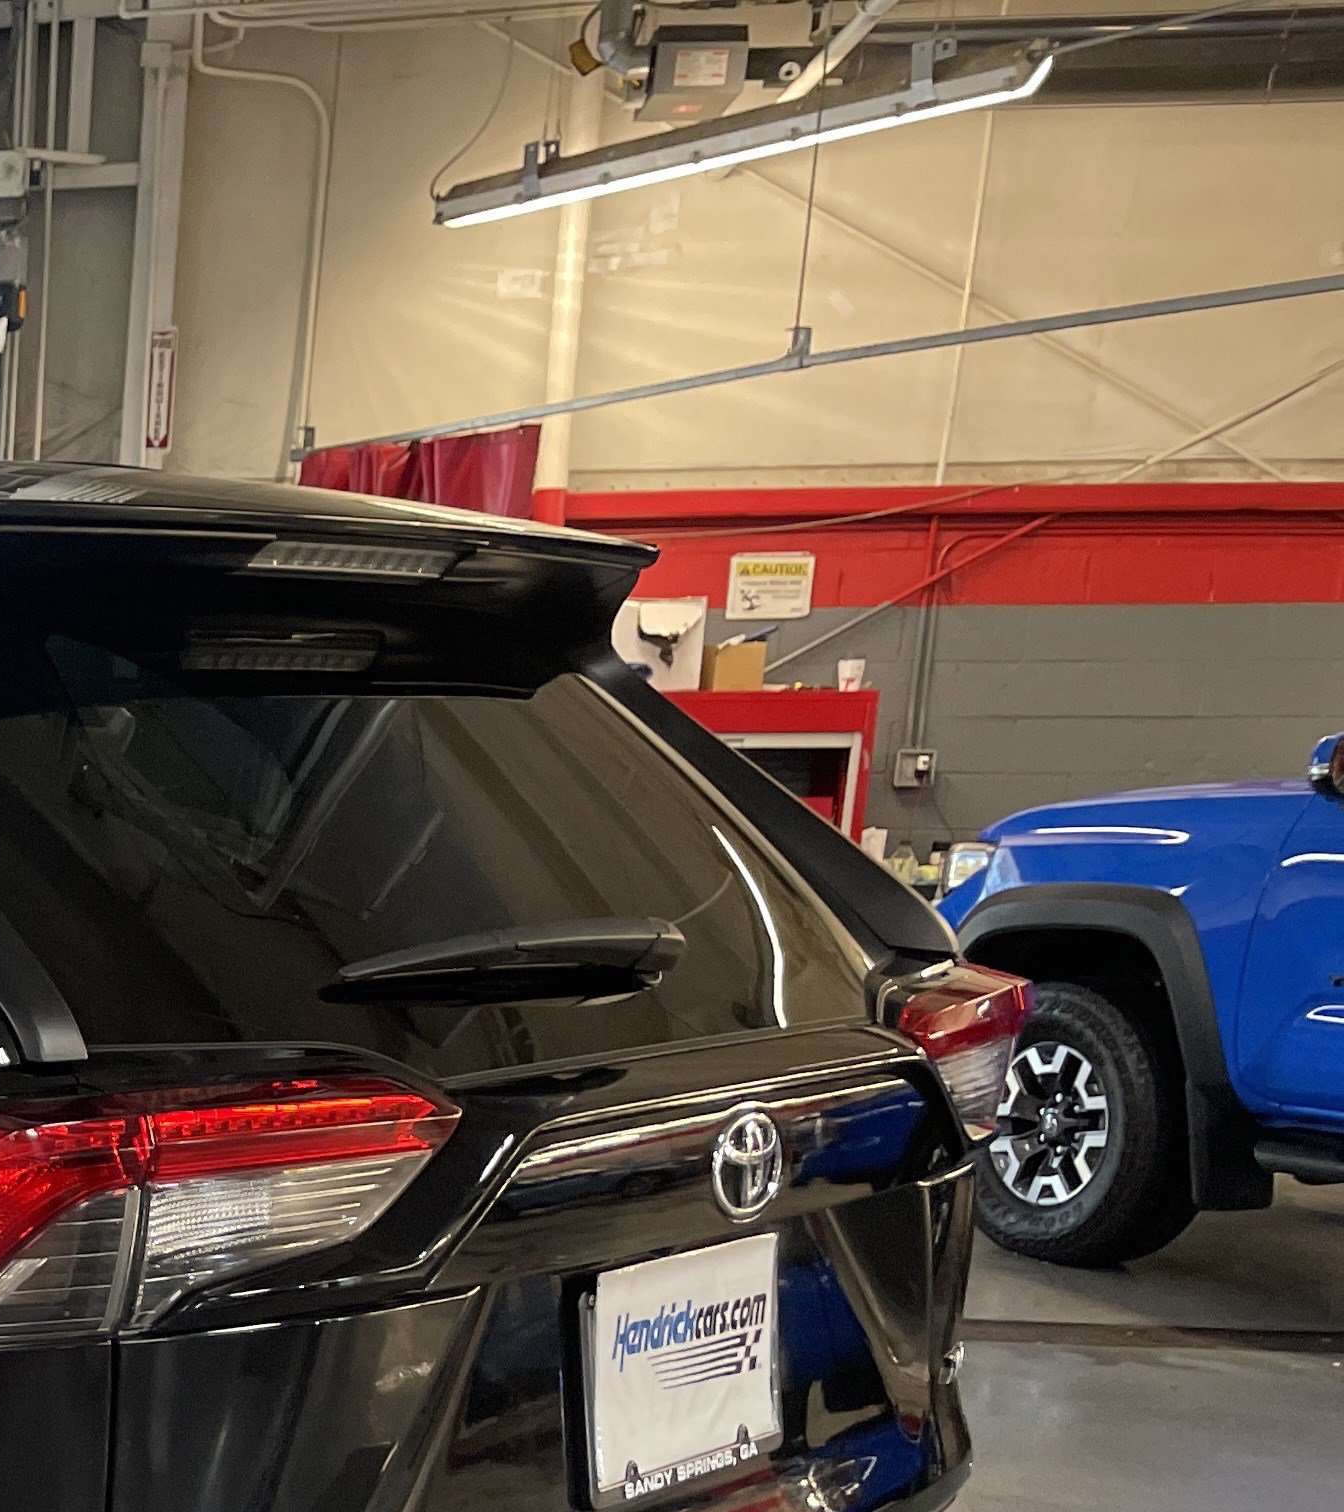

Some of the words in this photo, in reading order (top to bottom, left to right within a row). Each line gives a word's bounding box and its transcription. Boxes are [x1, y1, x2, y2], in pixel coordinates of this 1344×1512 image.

[752, 563, 806, 576] CAUTION
[612, 1293, 766, 1372] Hendrickcars.com
[624, 1469, 673, 1500] SANDY
[676, 1449, 737, 1482] SPRINGS,
[739, 1441, 759, 1461] GA
